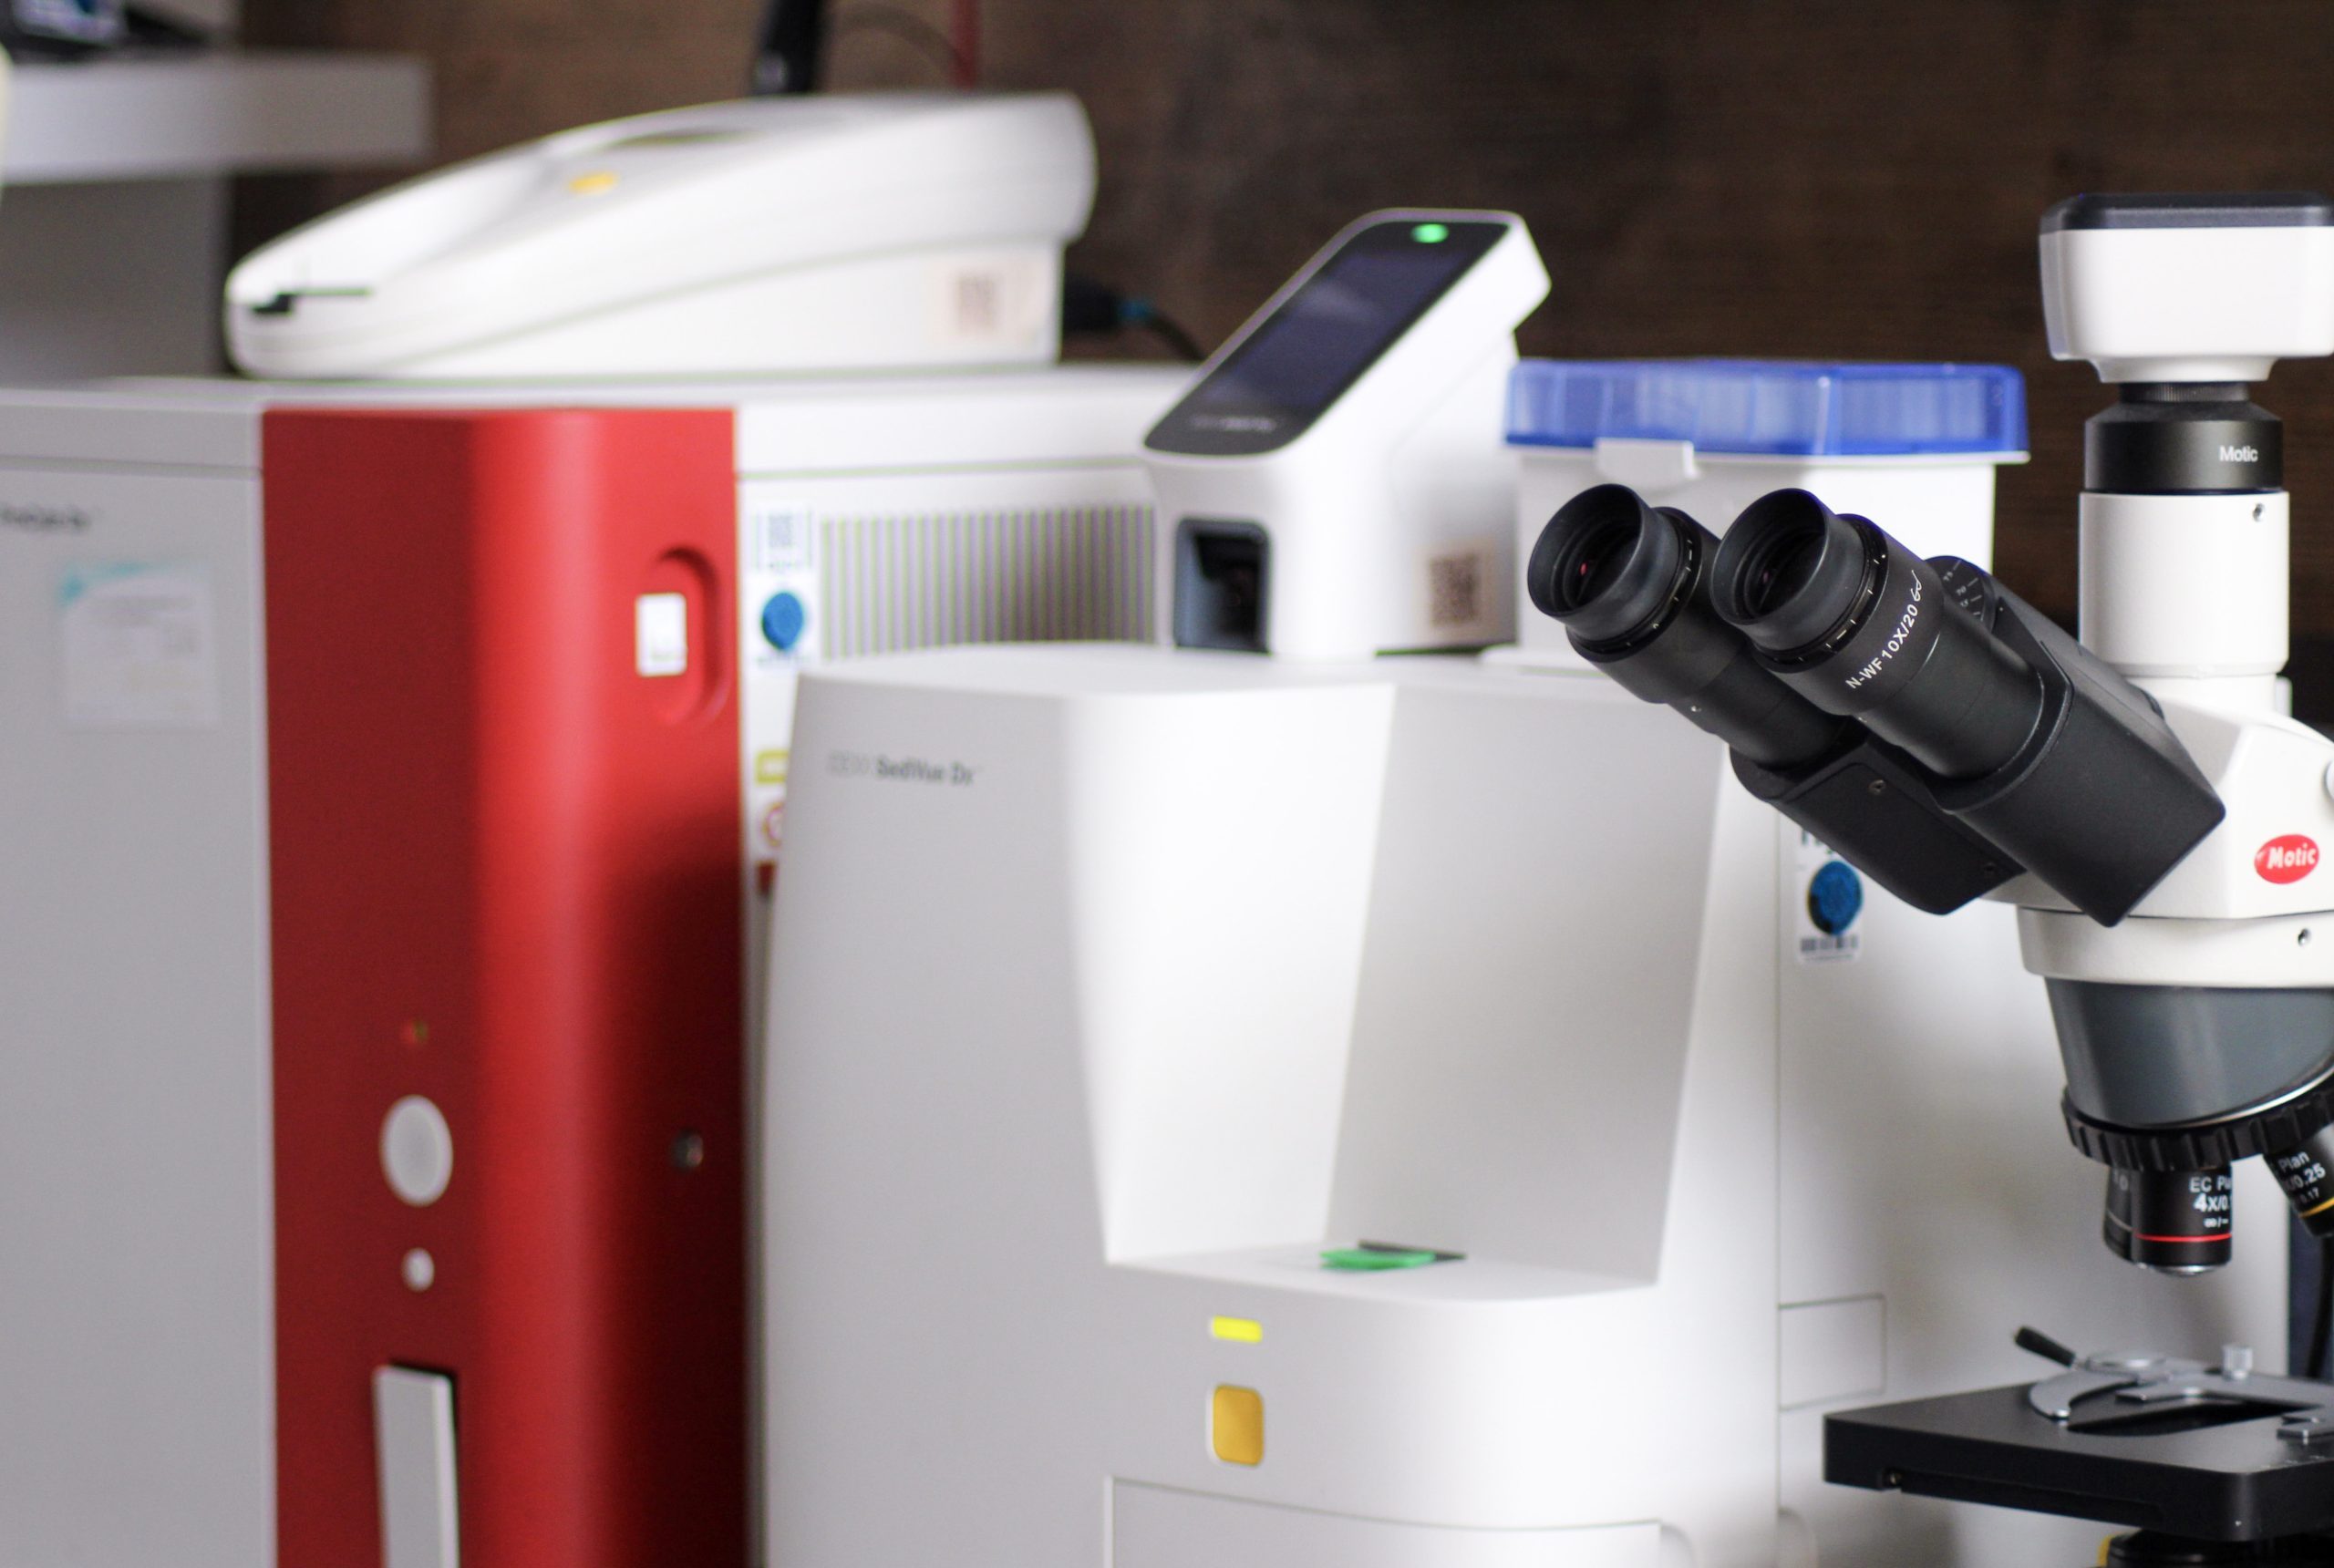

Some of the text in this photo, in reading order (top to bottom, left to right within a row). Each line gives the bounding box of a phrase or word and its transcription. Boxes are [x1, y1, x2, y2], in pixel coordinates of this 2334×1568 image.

[2218, 445, 2258, 462] Motic
[1844, 603, 1918, 689] N-WF 10X/20
[2267, 841, 2317, 870] Motic
[2278, 1151, 2310, 1173] Plan
[2189, 1176, 2212, 1193] EC
